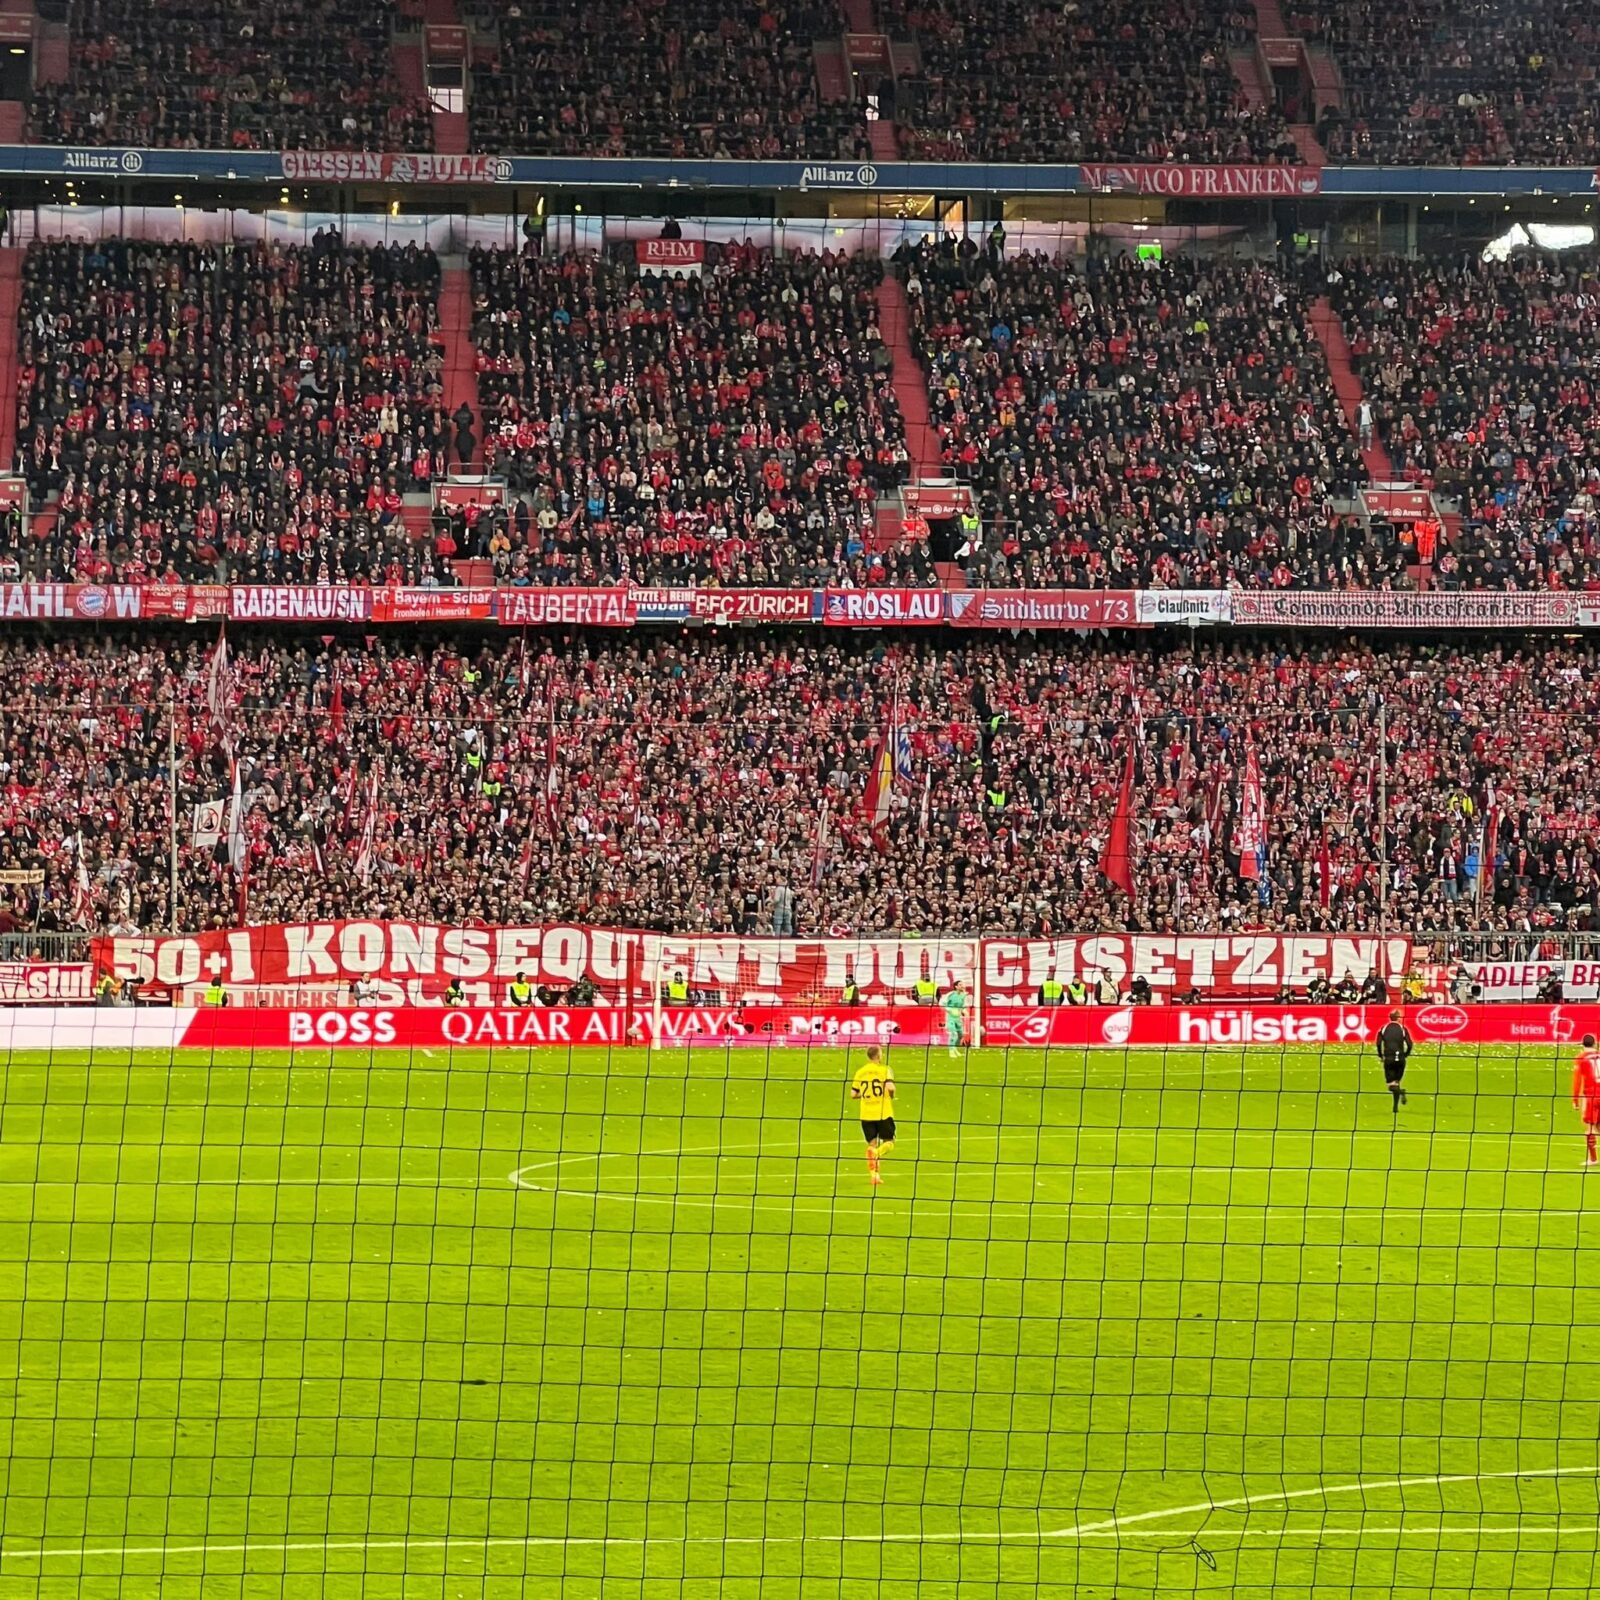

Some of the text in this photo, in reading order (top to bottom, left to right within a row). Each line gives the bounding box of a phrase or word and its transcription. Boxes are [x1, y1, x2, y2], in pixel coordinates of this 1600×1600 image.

[63, 153, 118, 168] Allianz
[281, 153, 497, 182] GIESSEN BULLS
[801, 167, 854, 182] Allianz
[1190, 168, 1297, 194] FRANKEN
[647, 241, 696, 257] RHM
[0, 585, 74, 617] AHL
[232, 588, 365, 619] RABENAU/SN
[372, 589, 390, 606] FC
[394, 590, 441, 608] Bayern
[500, 592, 635, 627] TAUBERTAL
[695, 595, 735, 614] BFC
[737, 593, 809, 615] ZÜRICH
[847, 592, 941, 620] RÖSLAU
[980, 597, 1129, 620] Südkurve '73
[1157, 599, 1210, 614] Claußnitz
[1273, 598, 1535, 621] Commando Unterfranken
[112, 921, 1408, 989] 50+1 KONSEQUENT DURCHSETZEN!
[288, 1010, 397, 1043] BOSS
[441, 1010, 747, 1044] QATAR AIRWAYS
[789, 1016, 899, 1036] Miele
[1023, 1016, 1050, 1039] 3
[1178, 1010, 1329, 1042] hülsta
[1420, 1014, 1463, 1025] RÖSLE
[1510, 1023, 1546, 1035] Istrien
[860, 1078, 883, 1099] 26
